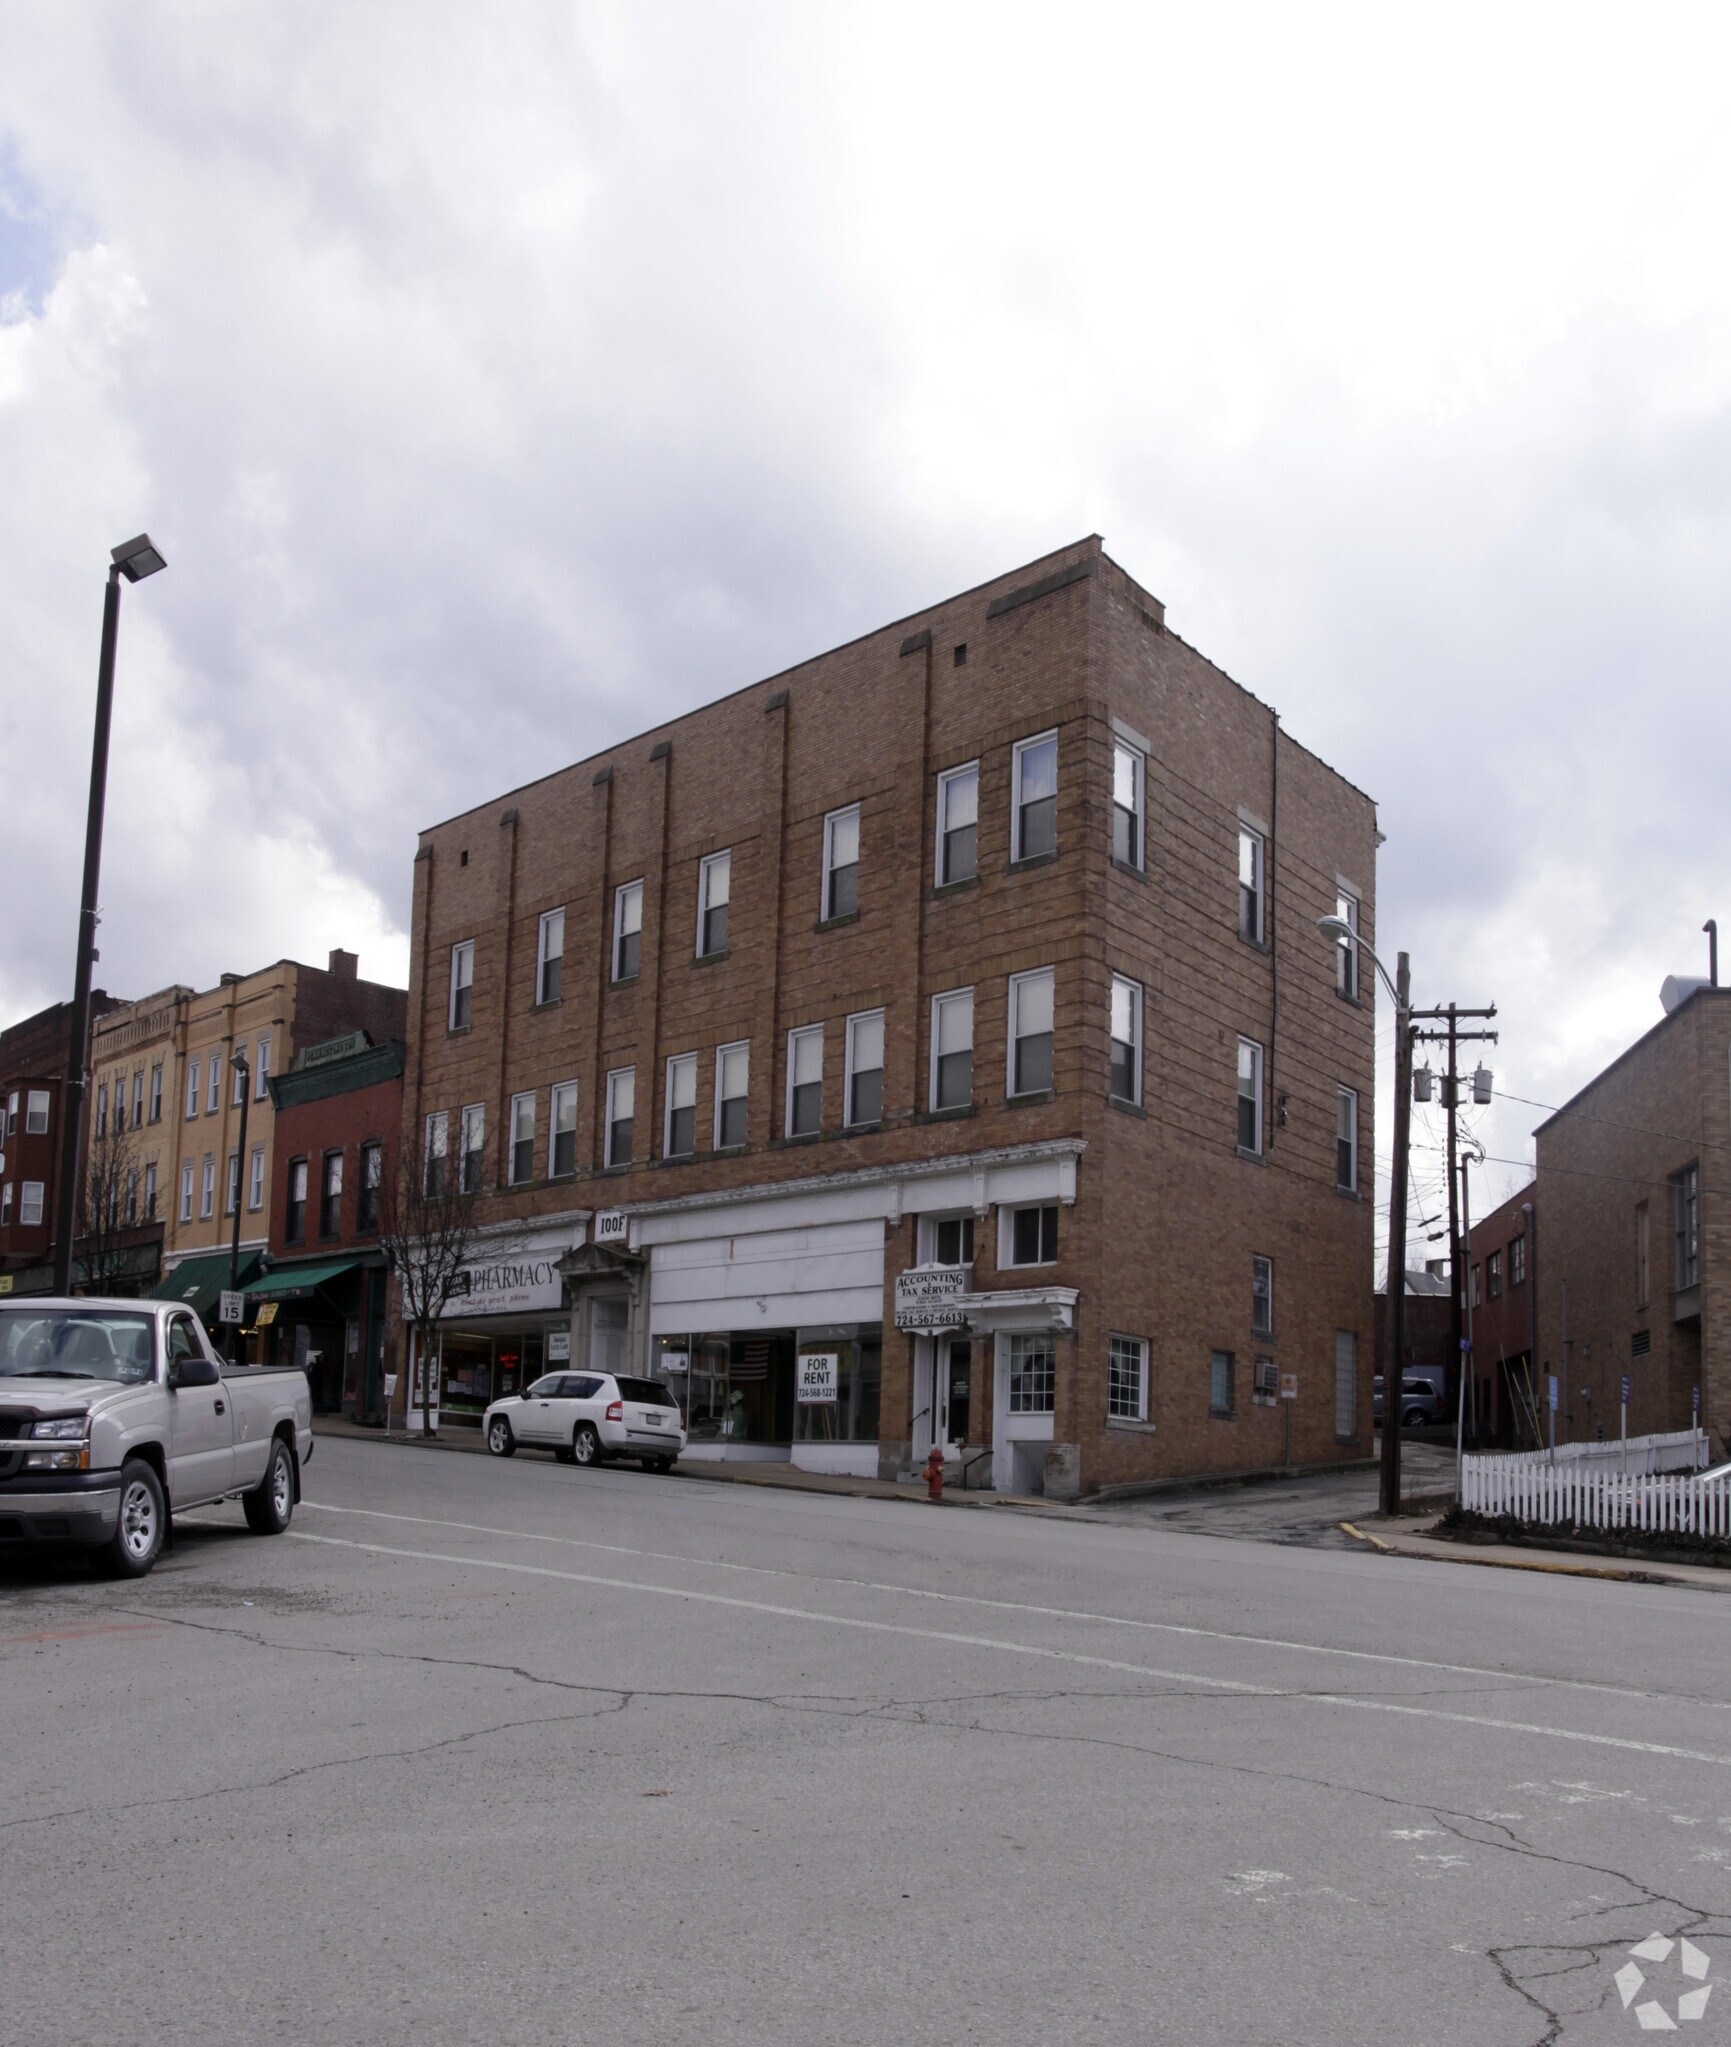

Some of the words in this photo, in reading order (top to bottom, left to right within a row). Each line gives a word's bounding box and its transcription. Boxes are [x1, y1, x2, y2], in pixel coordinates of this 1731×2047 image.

[473, 1262, 556, 1291] PHARMACY
[897, 1273, 963, 1289] ACCOUNTING
[901, 1287, 918, 1296] TAX
[921, 1285, 959, 1295] SERVICE
[223, 1293, 243, 1301] SPEED
[224, 1307, 239, 1319] 15
[896, 1312, 962, 1326] 724-567-6613
[807, 1358, 828, 1370] FOR
[804, 1371, 831, 1384] RENT
[798, 1388, 836, 1397] 724-568-1221
